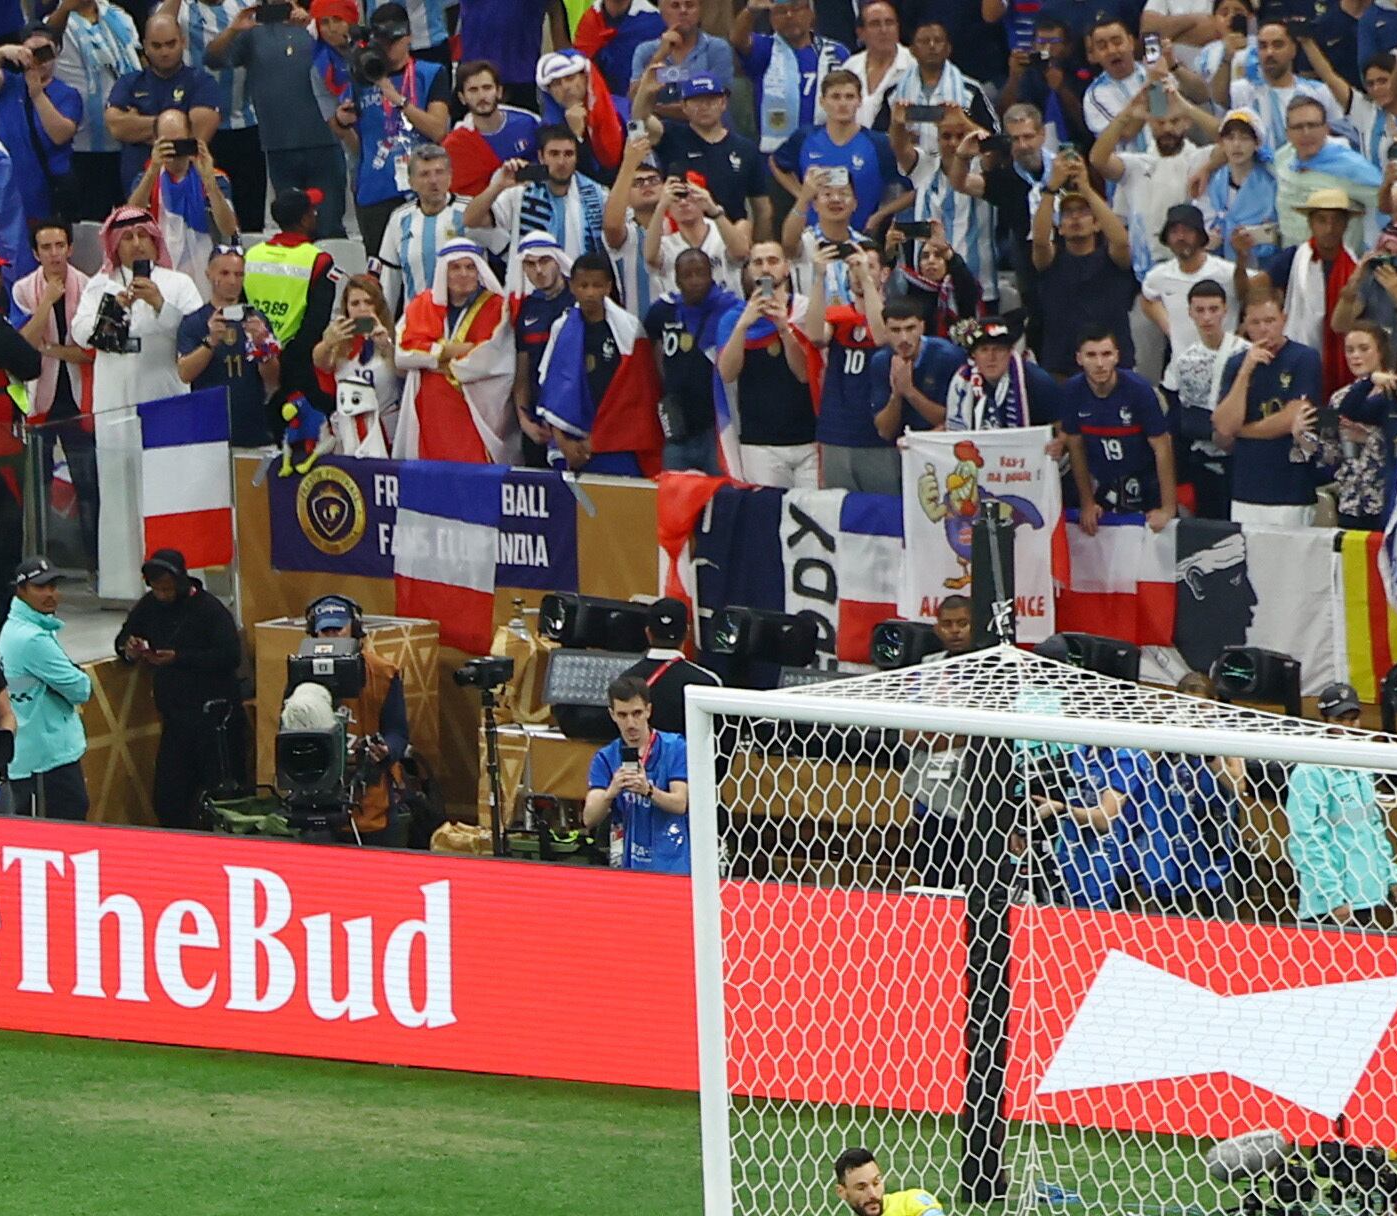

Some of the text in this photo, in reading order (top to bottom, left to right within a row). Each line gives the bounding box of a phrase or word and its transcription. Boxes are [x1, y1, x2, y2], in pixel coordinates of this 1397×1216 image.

[803, 72, 816, 96] 7
[223, 354, 243, 378] 11
[843, 349, 865, 375] 10
[1101, 437, 1124, 461] 19
[373, 474, 550, 519] FR BALL
